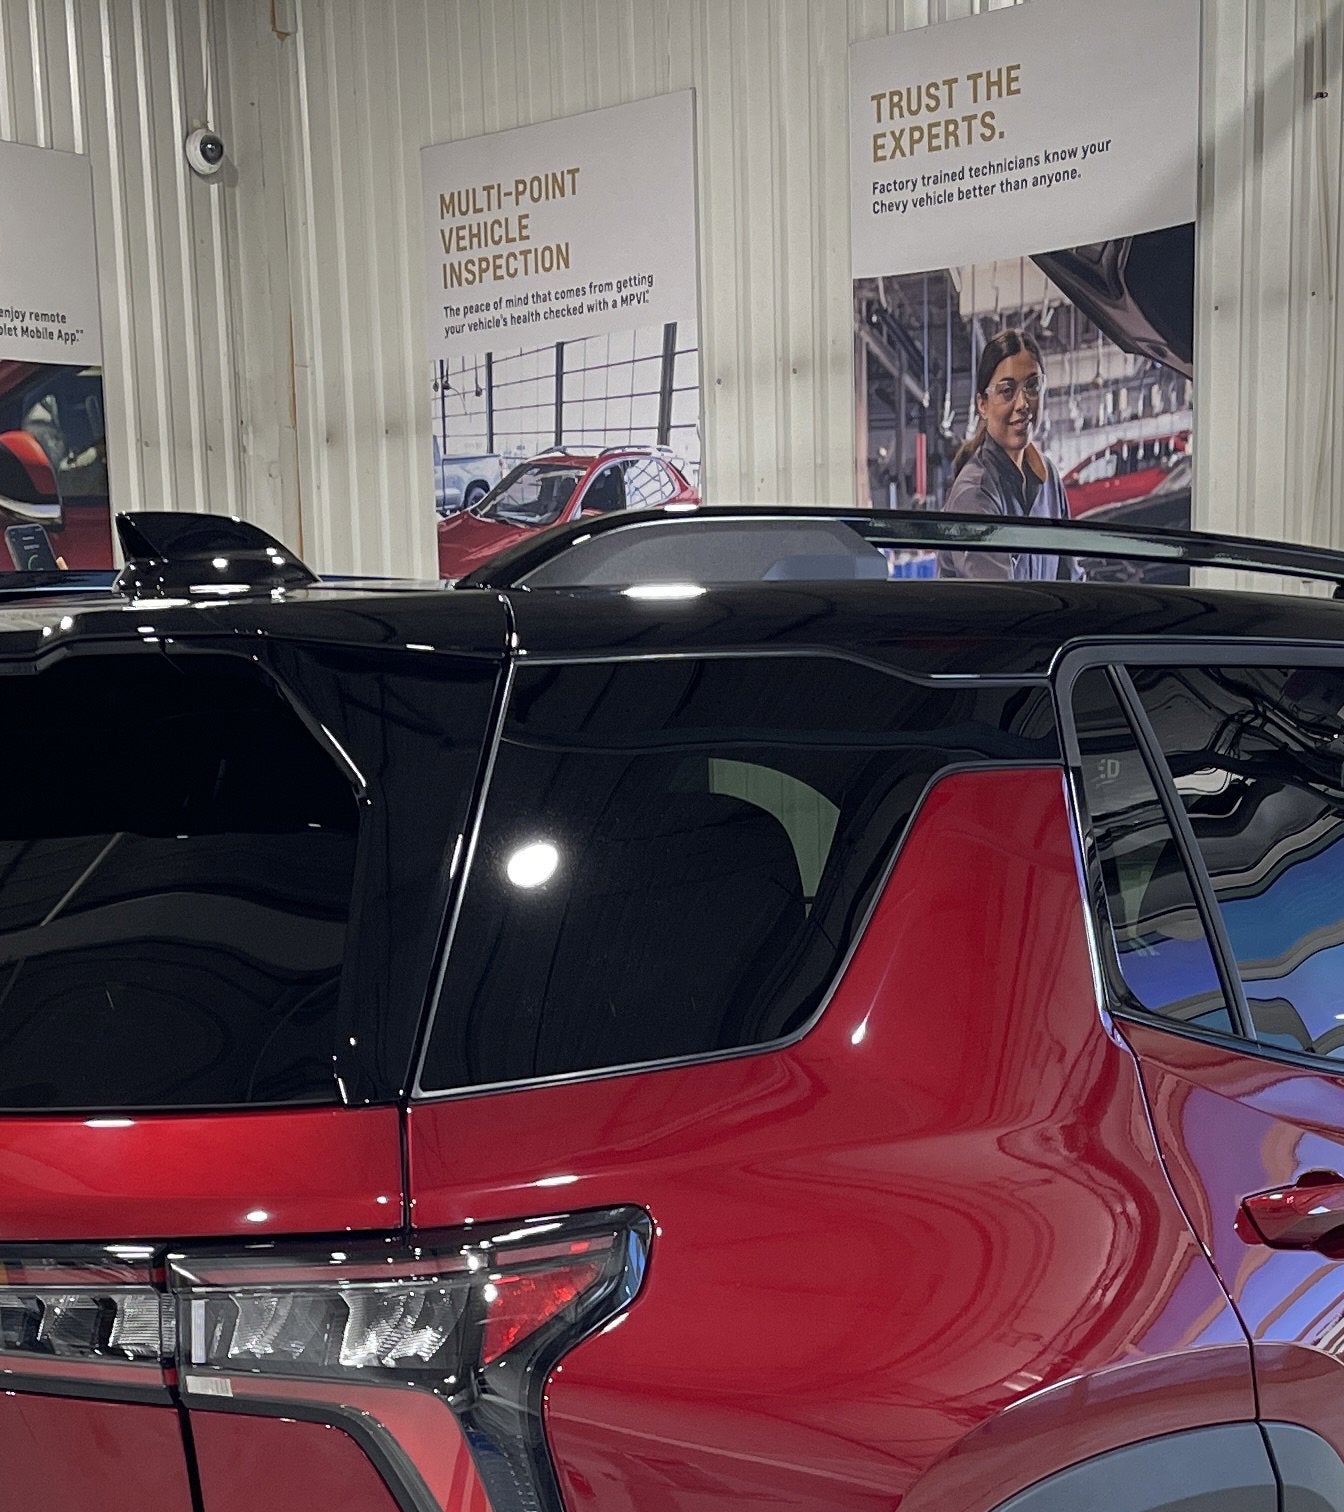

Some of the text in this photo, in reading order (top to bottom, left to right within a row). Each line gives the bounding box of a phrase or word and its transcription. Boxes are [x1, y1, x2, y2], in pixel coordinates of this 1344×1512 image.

[870, 63, 1021, 124] TRUST THE
[872, 110, 1005, 163] EXPERTS.
[872, 139, 1112, 196] Factory trained technicians know your
[439, 167, 580, 220] MULTI-POINT
[873, 168, 1082, 215] Chevy vehicle better than anyone.
[440, 213, 530, 254] VEHICLE
[442, 241, 570, 290] INSPECTION
[29, 311, 67, 324] remote
[444, 272, 654, 319] The peace of mind that comes from getting
[444, 324, 465, 339] your
[468, 314, 508, 332] vehicle's
[510, 308, 541, 325] health
[544, 302, 584, 321] checked
[587, 298, 609, 313] with
[611, 299, 618, 309] a
[20, 327, 54, 340] Mobile
